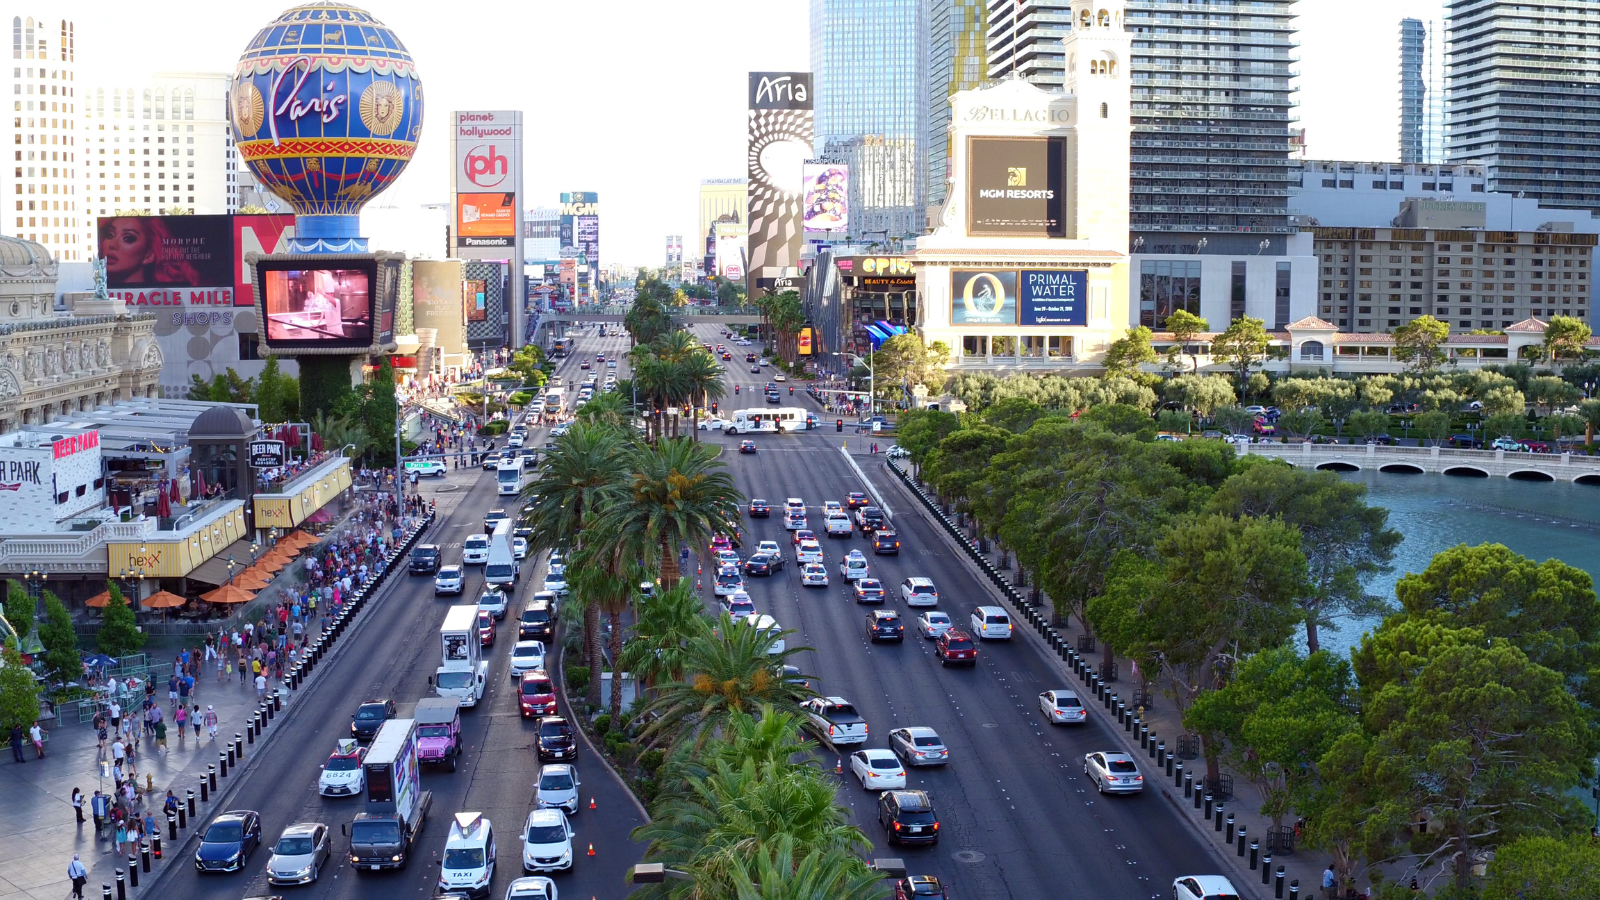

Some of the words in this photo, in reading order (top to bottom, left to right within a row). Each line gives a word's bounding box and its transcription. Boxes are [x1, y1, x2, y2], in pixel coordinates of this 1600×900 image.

[756, 76, 806, 104] Aria
[268, 55, 346, 147] Paris
[460, 112, 494, 124] planet
[964, 106, 1070, 122] BELLAGIO
[460, 126, 512, 138] hollywood
[470, 145, 508, 183] ph
[980, 189, 1004, 198] MGM
[1006, 190, 1054, 199] RESORTS
[560, 202, 598, 216] MGM
[1420, 202, 1456, 211] JOCKEY
[1460, 203, 1484, 212] CLUB
[862, 258, 917, 276] OPIU
[774, 278, 792, 287] Aria
[1030, 274, 1077, 284] PRIMAL
[1032, 286, 1074, 296] WATER
[191, 291, 231, 305] MILE
[173, 312, 232, 325] SHOPS
[54, 436, 76, 460] BEER
[78, 429, 99, 452] PARK
[252, 444, 266, 455] BEER
[267, 444, 281, 455] PARK
[10, 461, 41, 485] PARK
